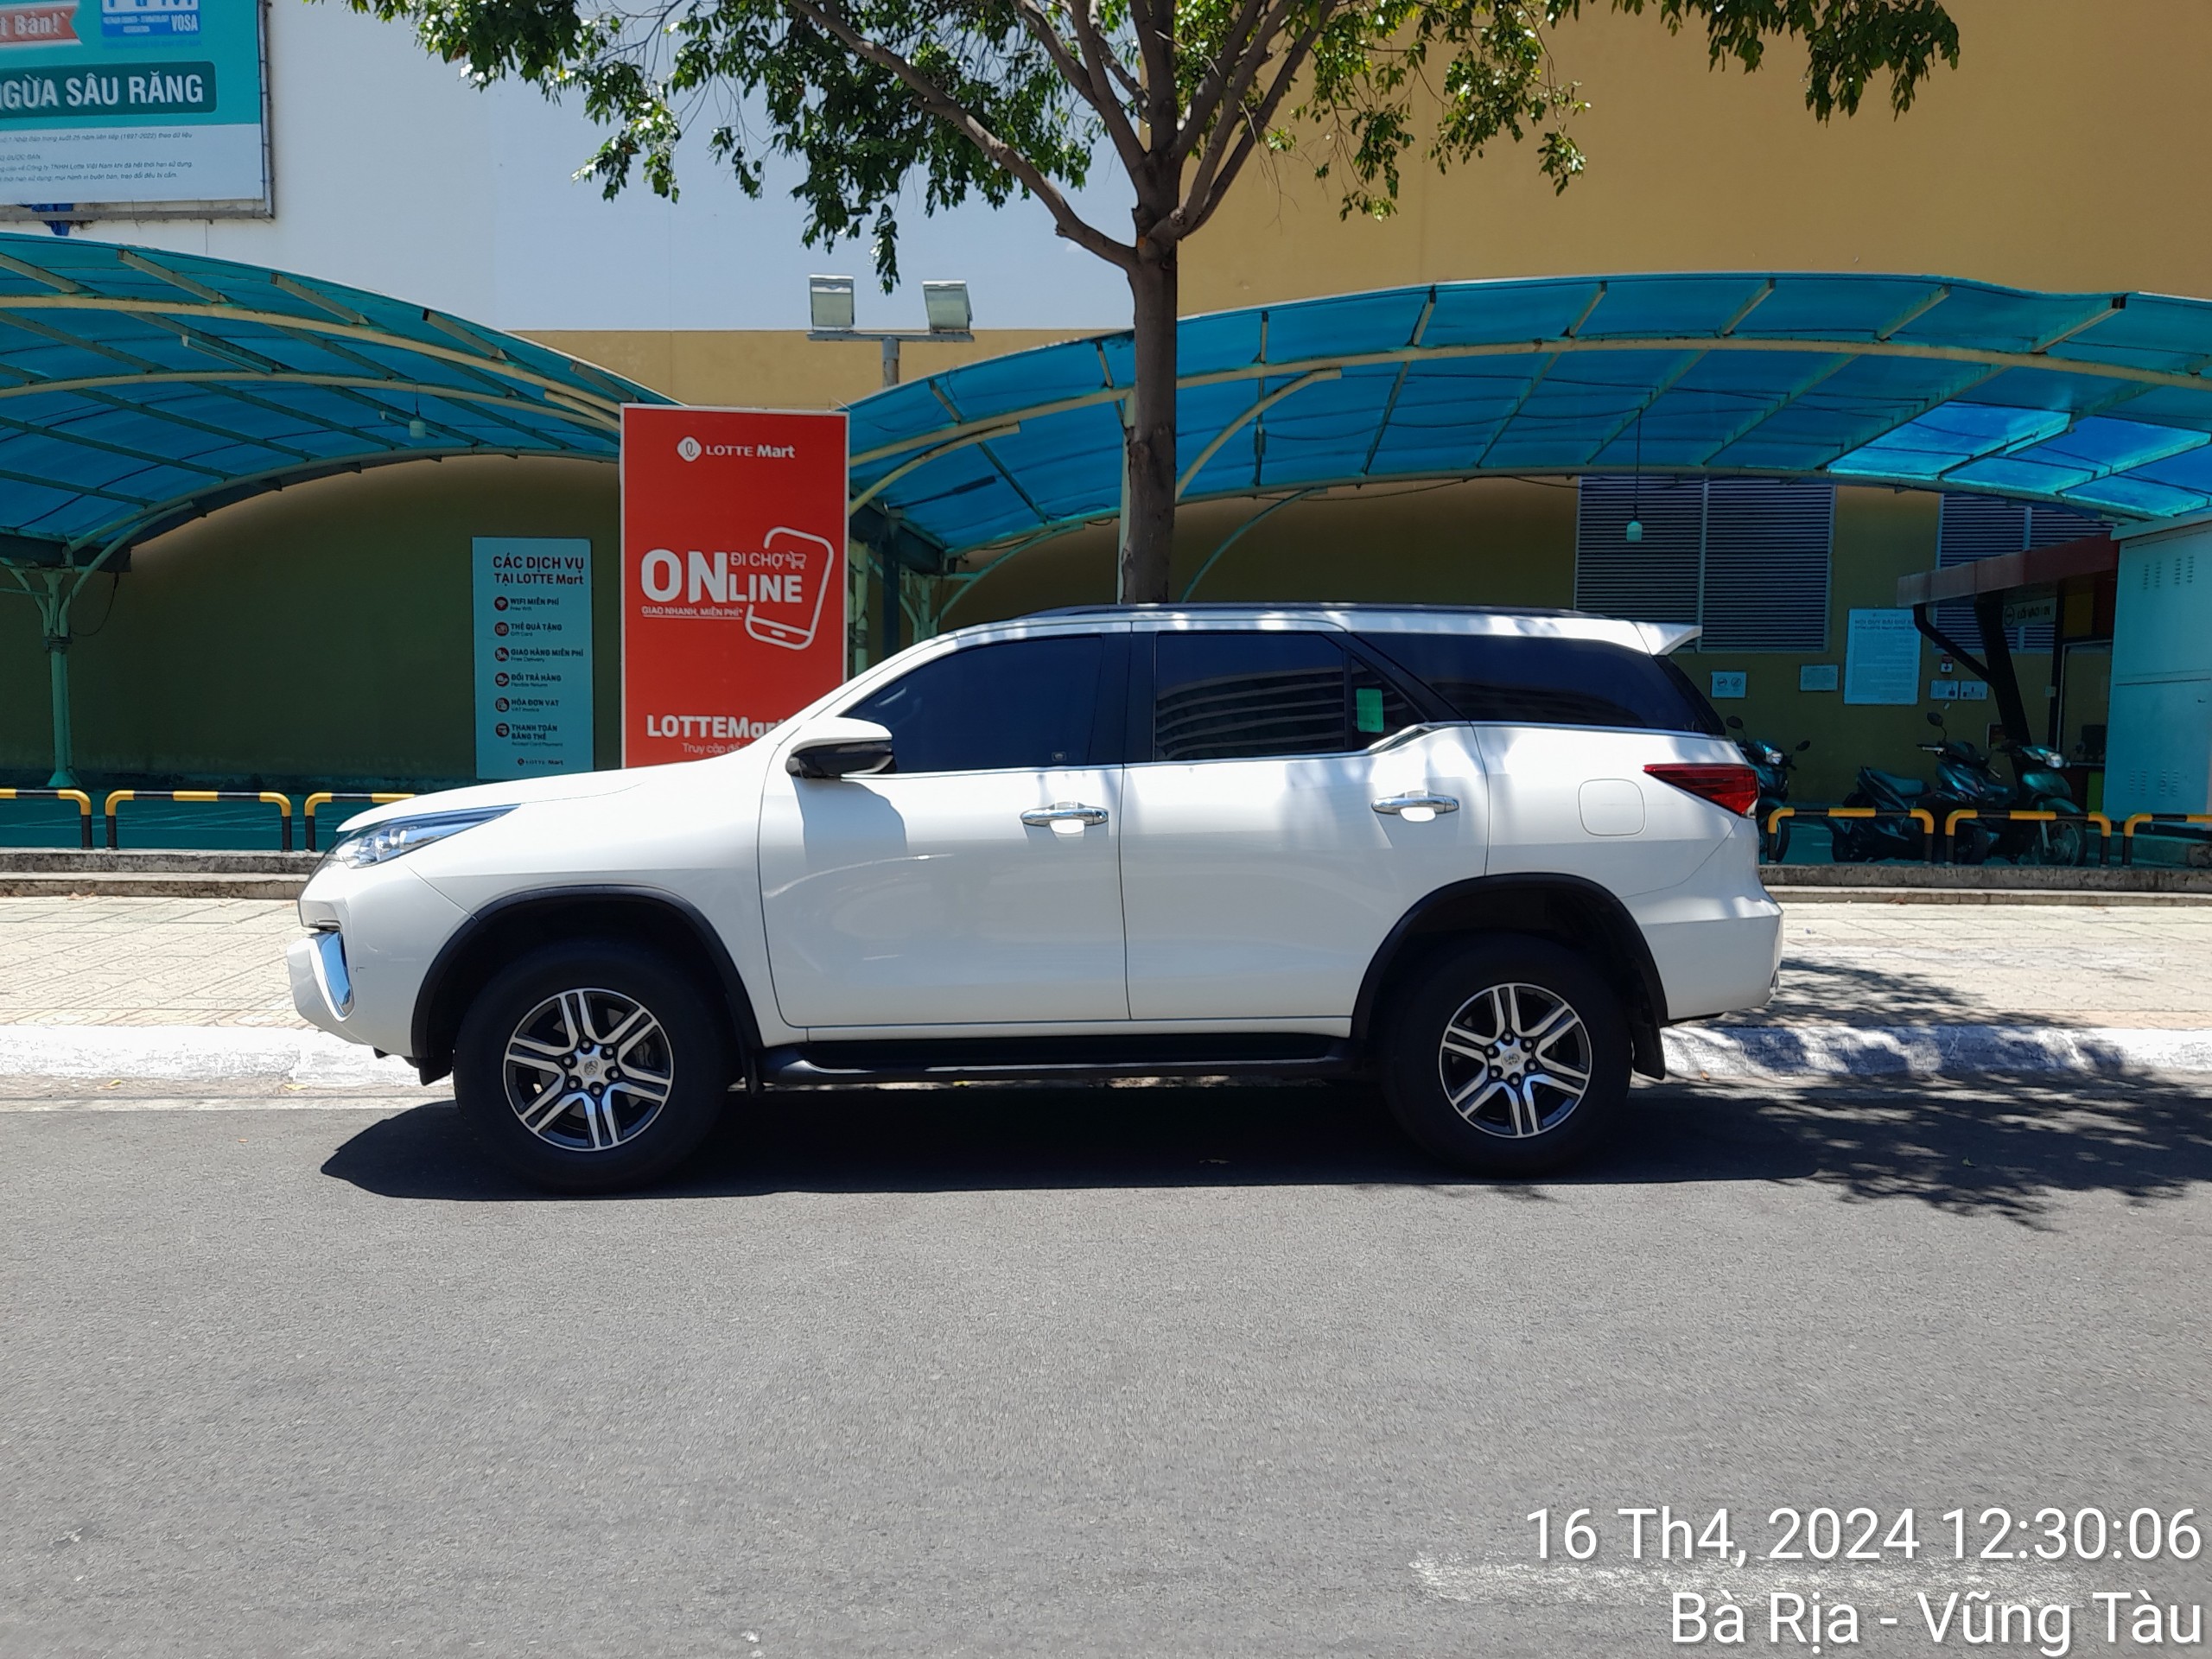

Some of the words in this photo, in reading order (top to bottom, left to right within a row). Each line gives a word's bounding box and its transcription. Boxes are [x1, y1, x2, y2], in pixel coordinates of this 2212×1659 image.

[171, 14, 199, 32] VOSA
[0, 73, 58, 110] GỪA
[66, 73, 118, 106] SÂU
[129, 71, 203, 105] RĂNG
[706, 444, 753, 457] LOTTE
[757, 444, 795, 459] Mart
[493, 552, 523, 569] CÁC
[526, 556, 561, 573] DỊCH
[564, 556, 584, 574] VỤ
[730, 551, 747, 567] ĐI
[748, 552, 785, 570] CHỢ
[494, 573, 513, 587] TẠI
[517, 573, 554, 585] LOTTE
[556, 575, 584, 585] Mart
[527, 596, 546, 606] MIỄN
[547, 597, 560, 607] PHÍ
[641, 606, 664, 615] GIAO
[700, 606, 722, 616] MIỄN
[511, 621, 524, 631] THẺ
[525, 621, 541, 632] QUÀ
[542, 622, 563, 632] TẶNG
[530, 647, 550, 657] HÀNG
[551, 647, 570, 658] MIỄN
[571, 648, 584, 658] PHÍ
[541, 672, 562, 683] HÀNG
[545, 699, 560, 708] VAT
[512, 723, 537, 733] THANH
[537, 723, 558, 734] TOÁN
[645, 714, 784, 739] LOTTEMar
[682, 742, 705, 755] Truy
[706, 743, 725, 754] cập
